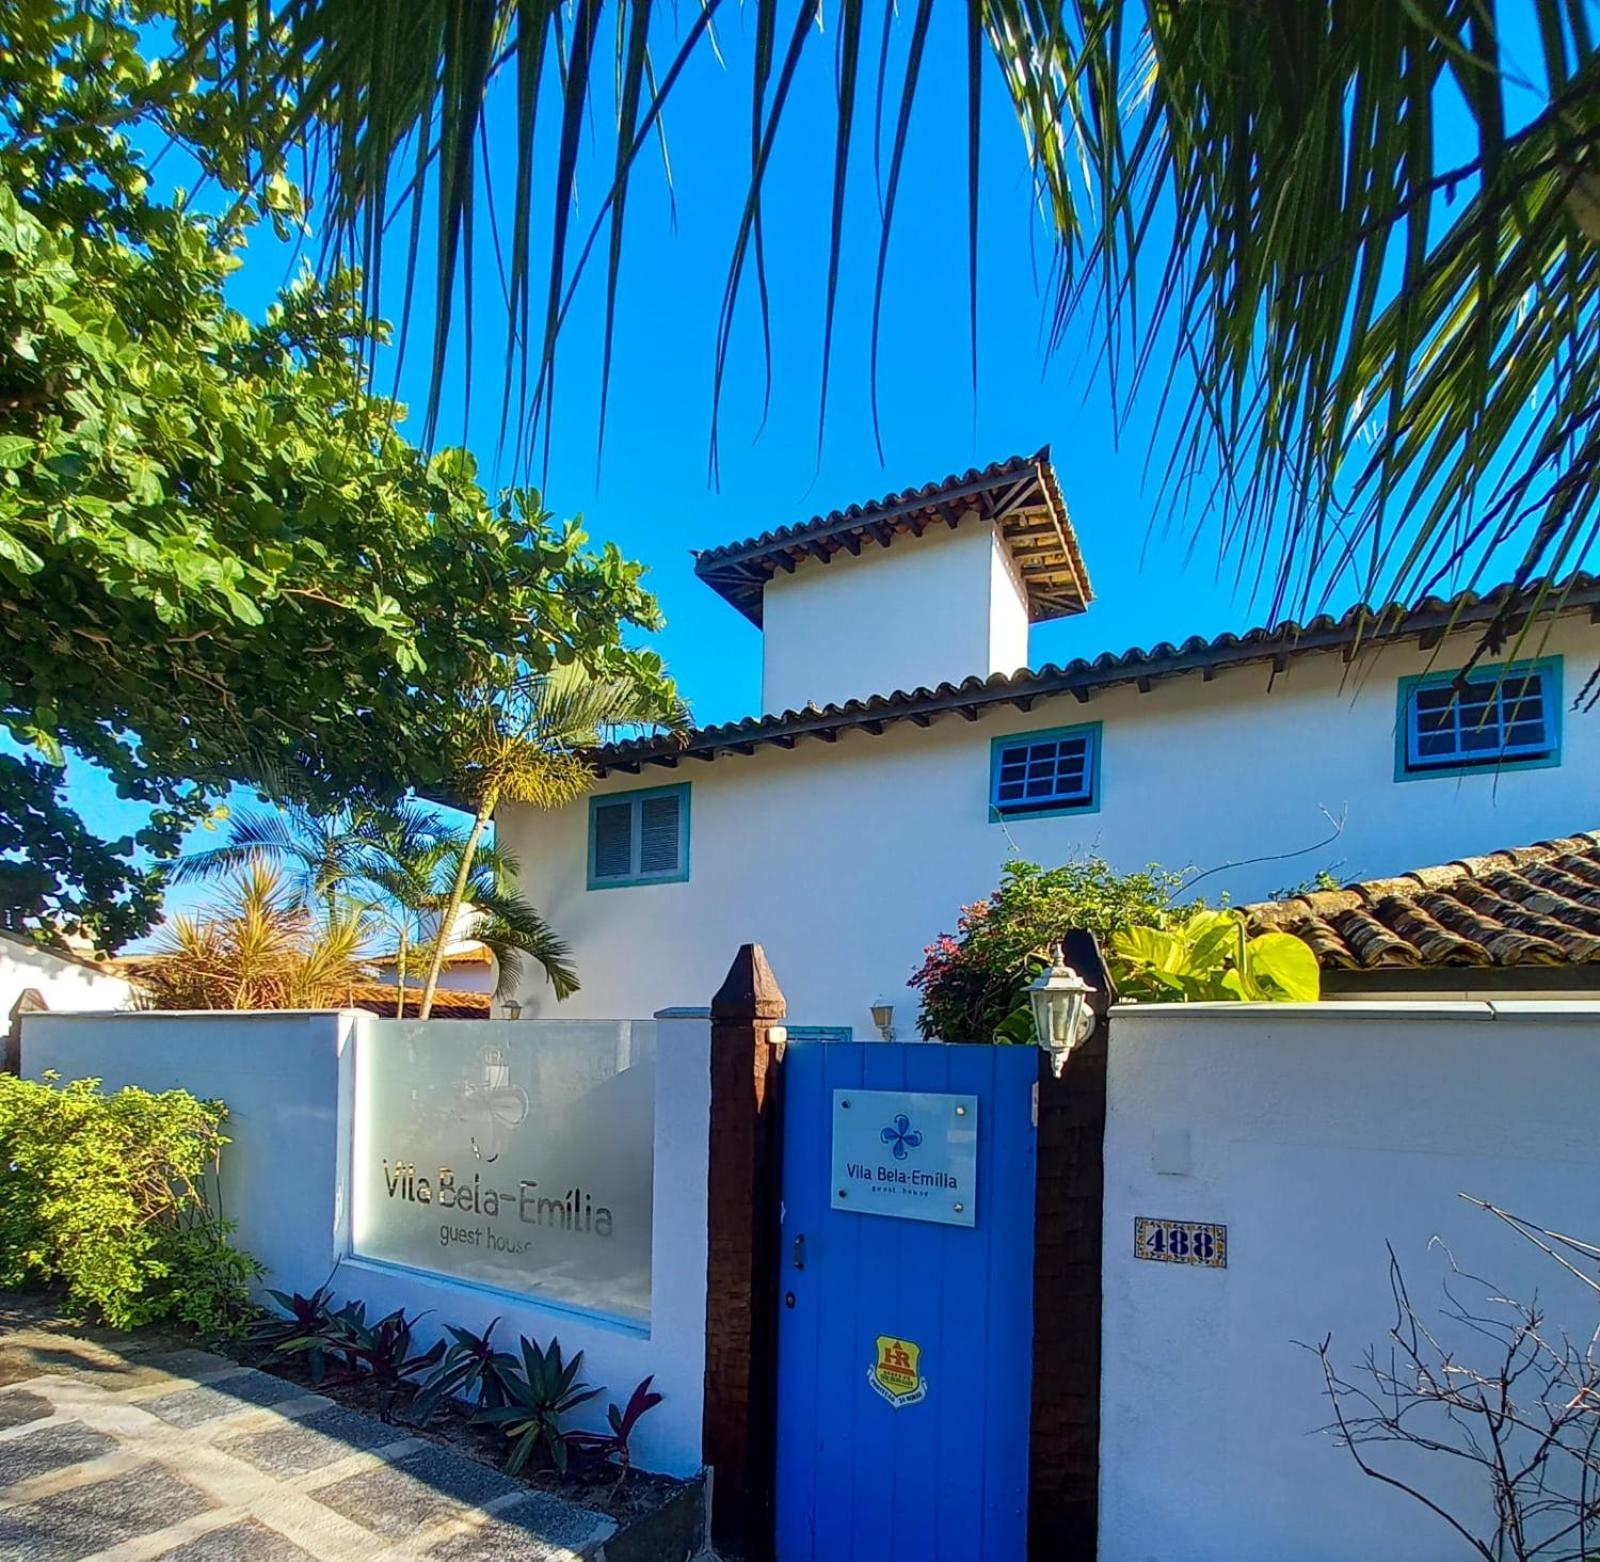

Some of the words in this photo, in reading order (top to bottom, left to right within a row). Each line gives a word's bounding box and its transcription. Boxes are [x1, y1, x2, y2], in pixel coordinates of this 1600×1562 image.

[383, 1159, 431, 1204] Vila
[847, 1163, 872, 1180] Vila
[440, 1224, 482, 1247] guest
[1146, 1228, 1214, 1258] 488
